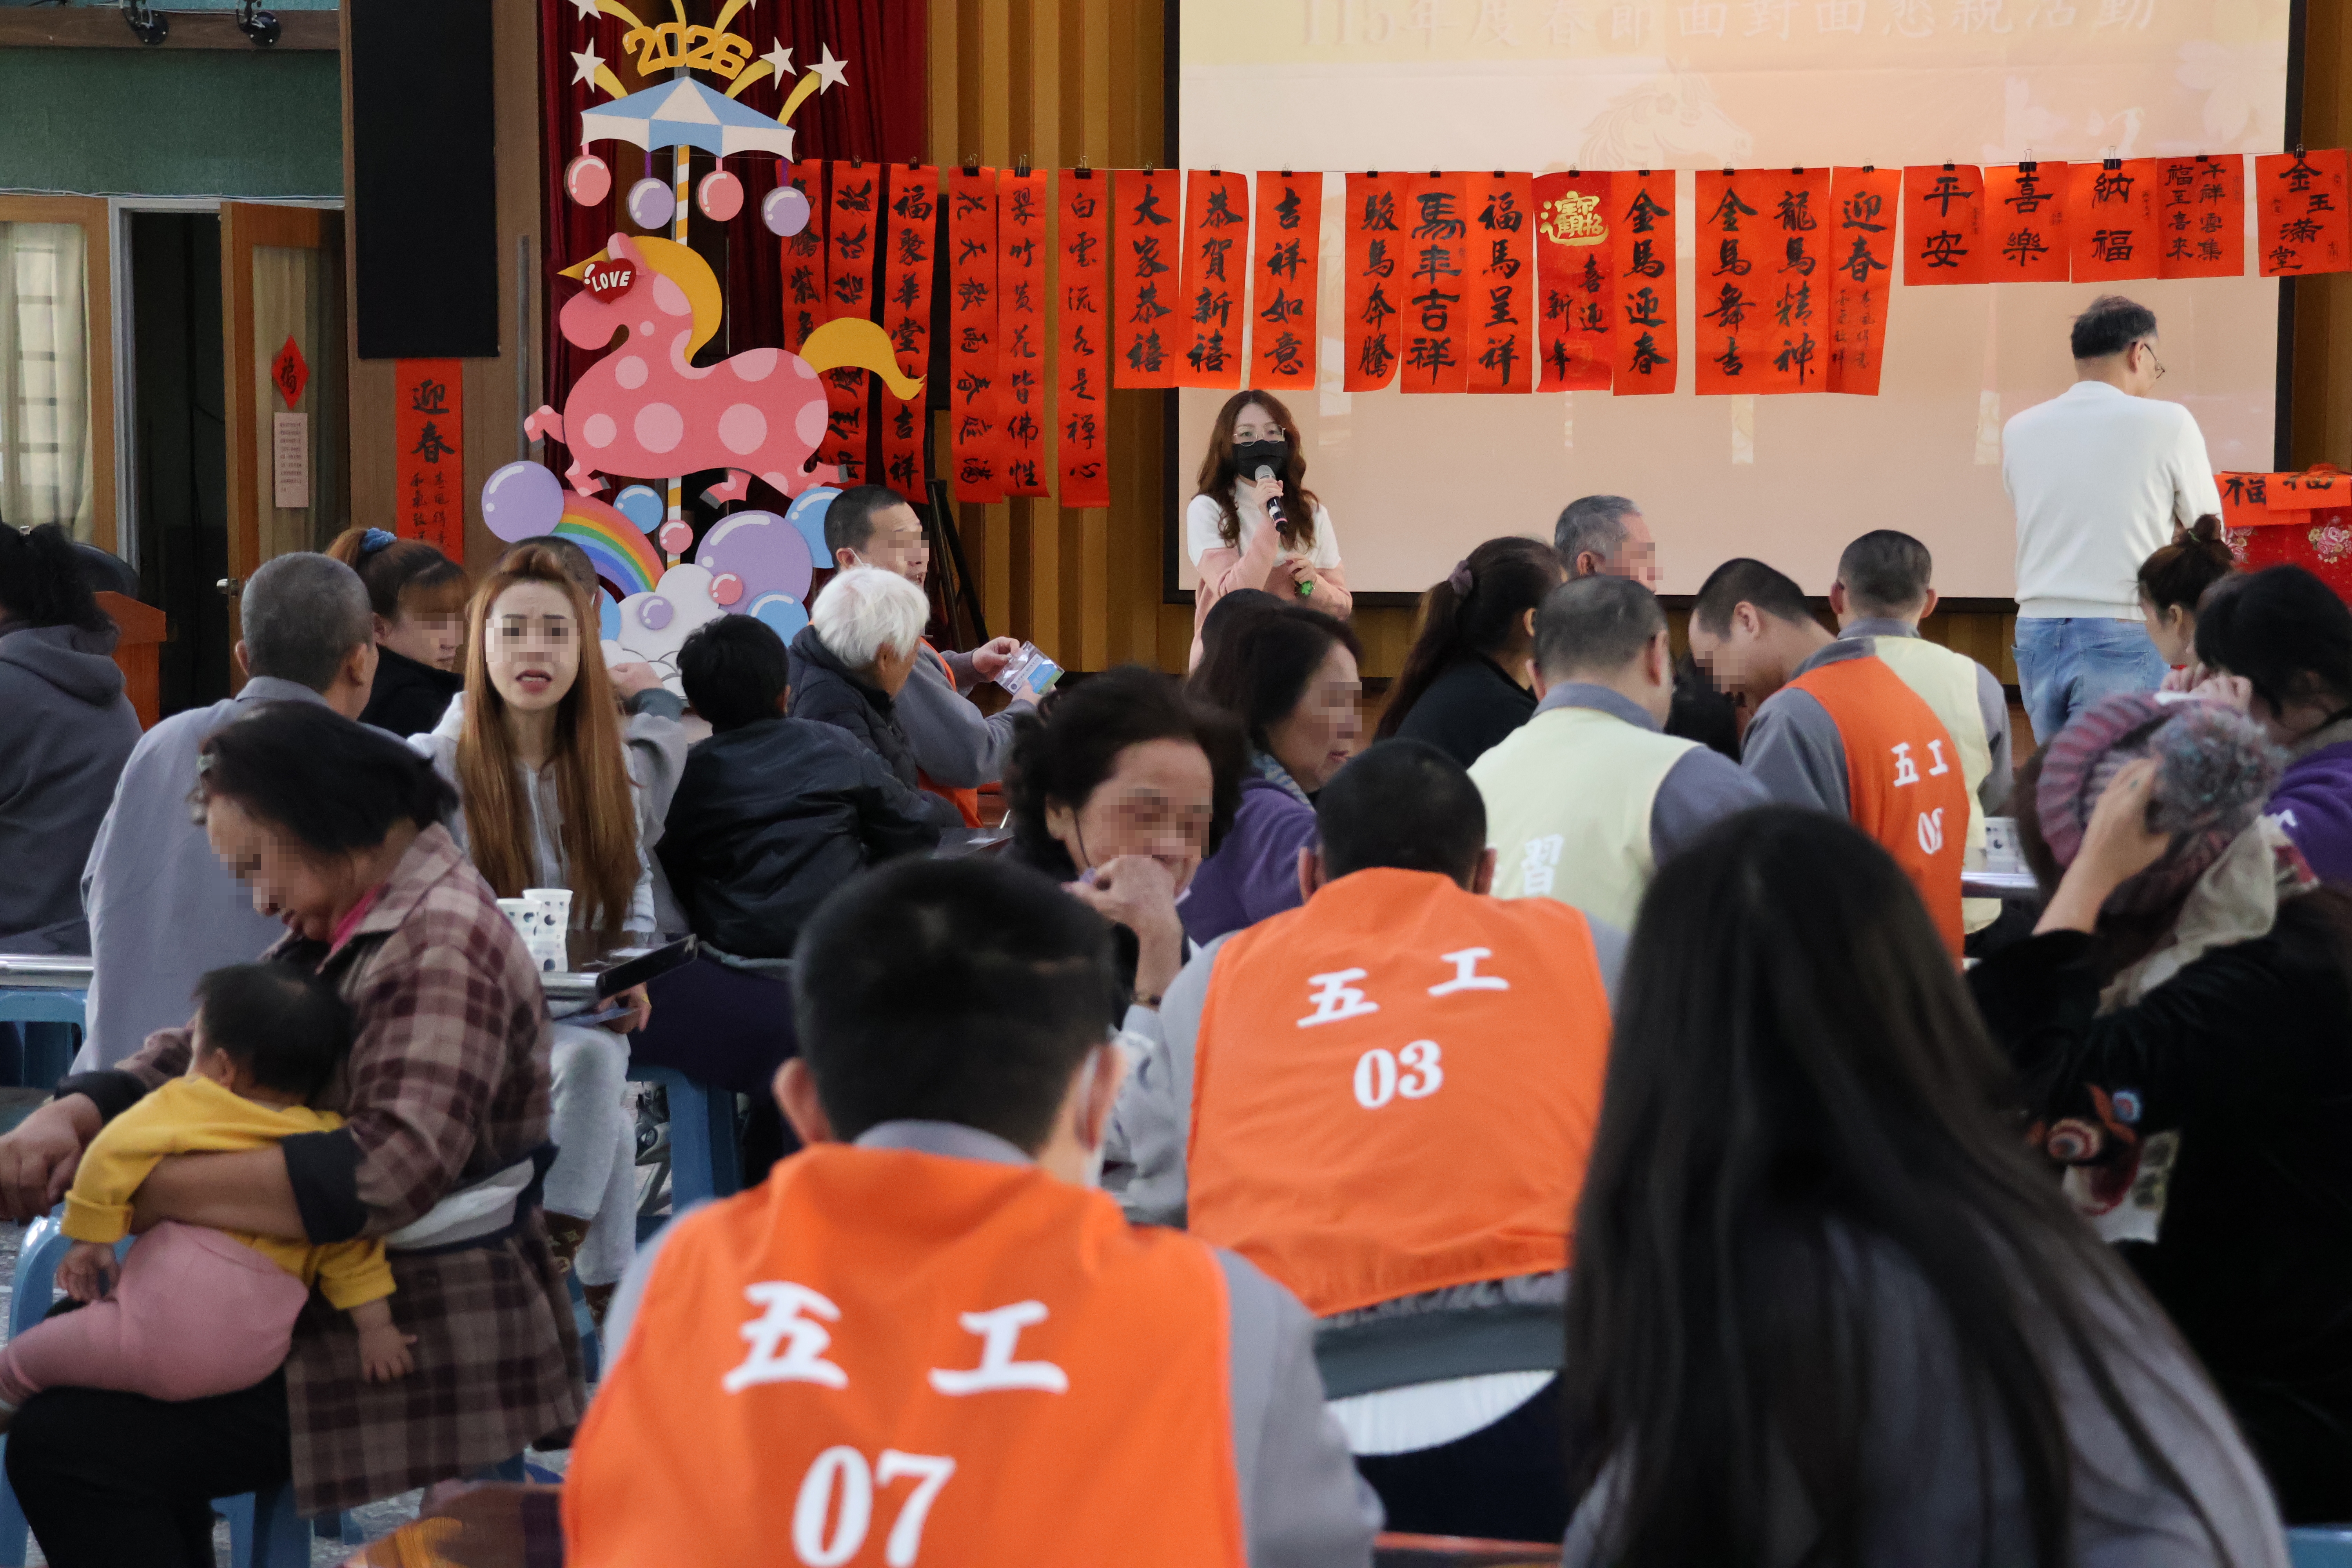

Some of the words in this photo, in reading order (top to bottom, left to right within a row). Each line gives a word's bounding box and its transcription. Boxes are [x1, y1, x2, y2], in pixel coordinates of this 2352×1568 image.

[622, 22, 753, 80] 2026
[1839, 191, 1887, 283] 迎春
[1921, 176, 1974, 267] 平安
[2003, 174, 2053, 267] 喜樂
[2092, 172, 2135, 262] 納福
[2269, 158, 2335, 273] 金玉滿堂
[592, 270, 630, 293] LOVE
[1126, 184, 1172, 372] 大家恭禧
[1186, 186, 1243, 372] 恭賀新禧
[1261, 187, 1307, 375] 吉祥如意
[1359, 191, 1399, 377] 駿馬奔騰
[1406, 192, 1466, 385] 馬年吉祥
[1478, 192, 1523, 387] 福馬呈祥
[1623, 189, 1670, 375] 金馬迎春
[1773, 191, 1817, 385] 龍馬精神
[411, 379, 455, 464] 迎春
[1353, 1039, 1444, 1110] 03
[791, 1445, 957, 1568] 07
